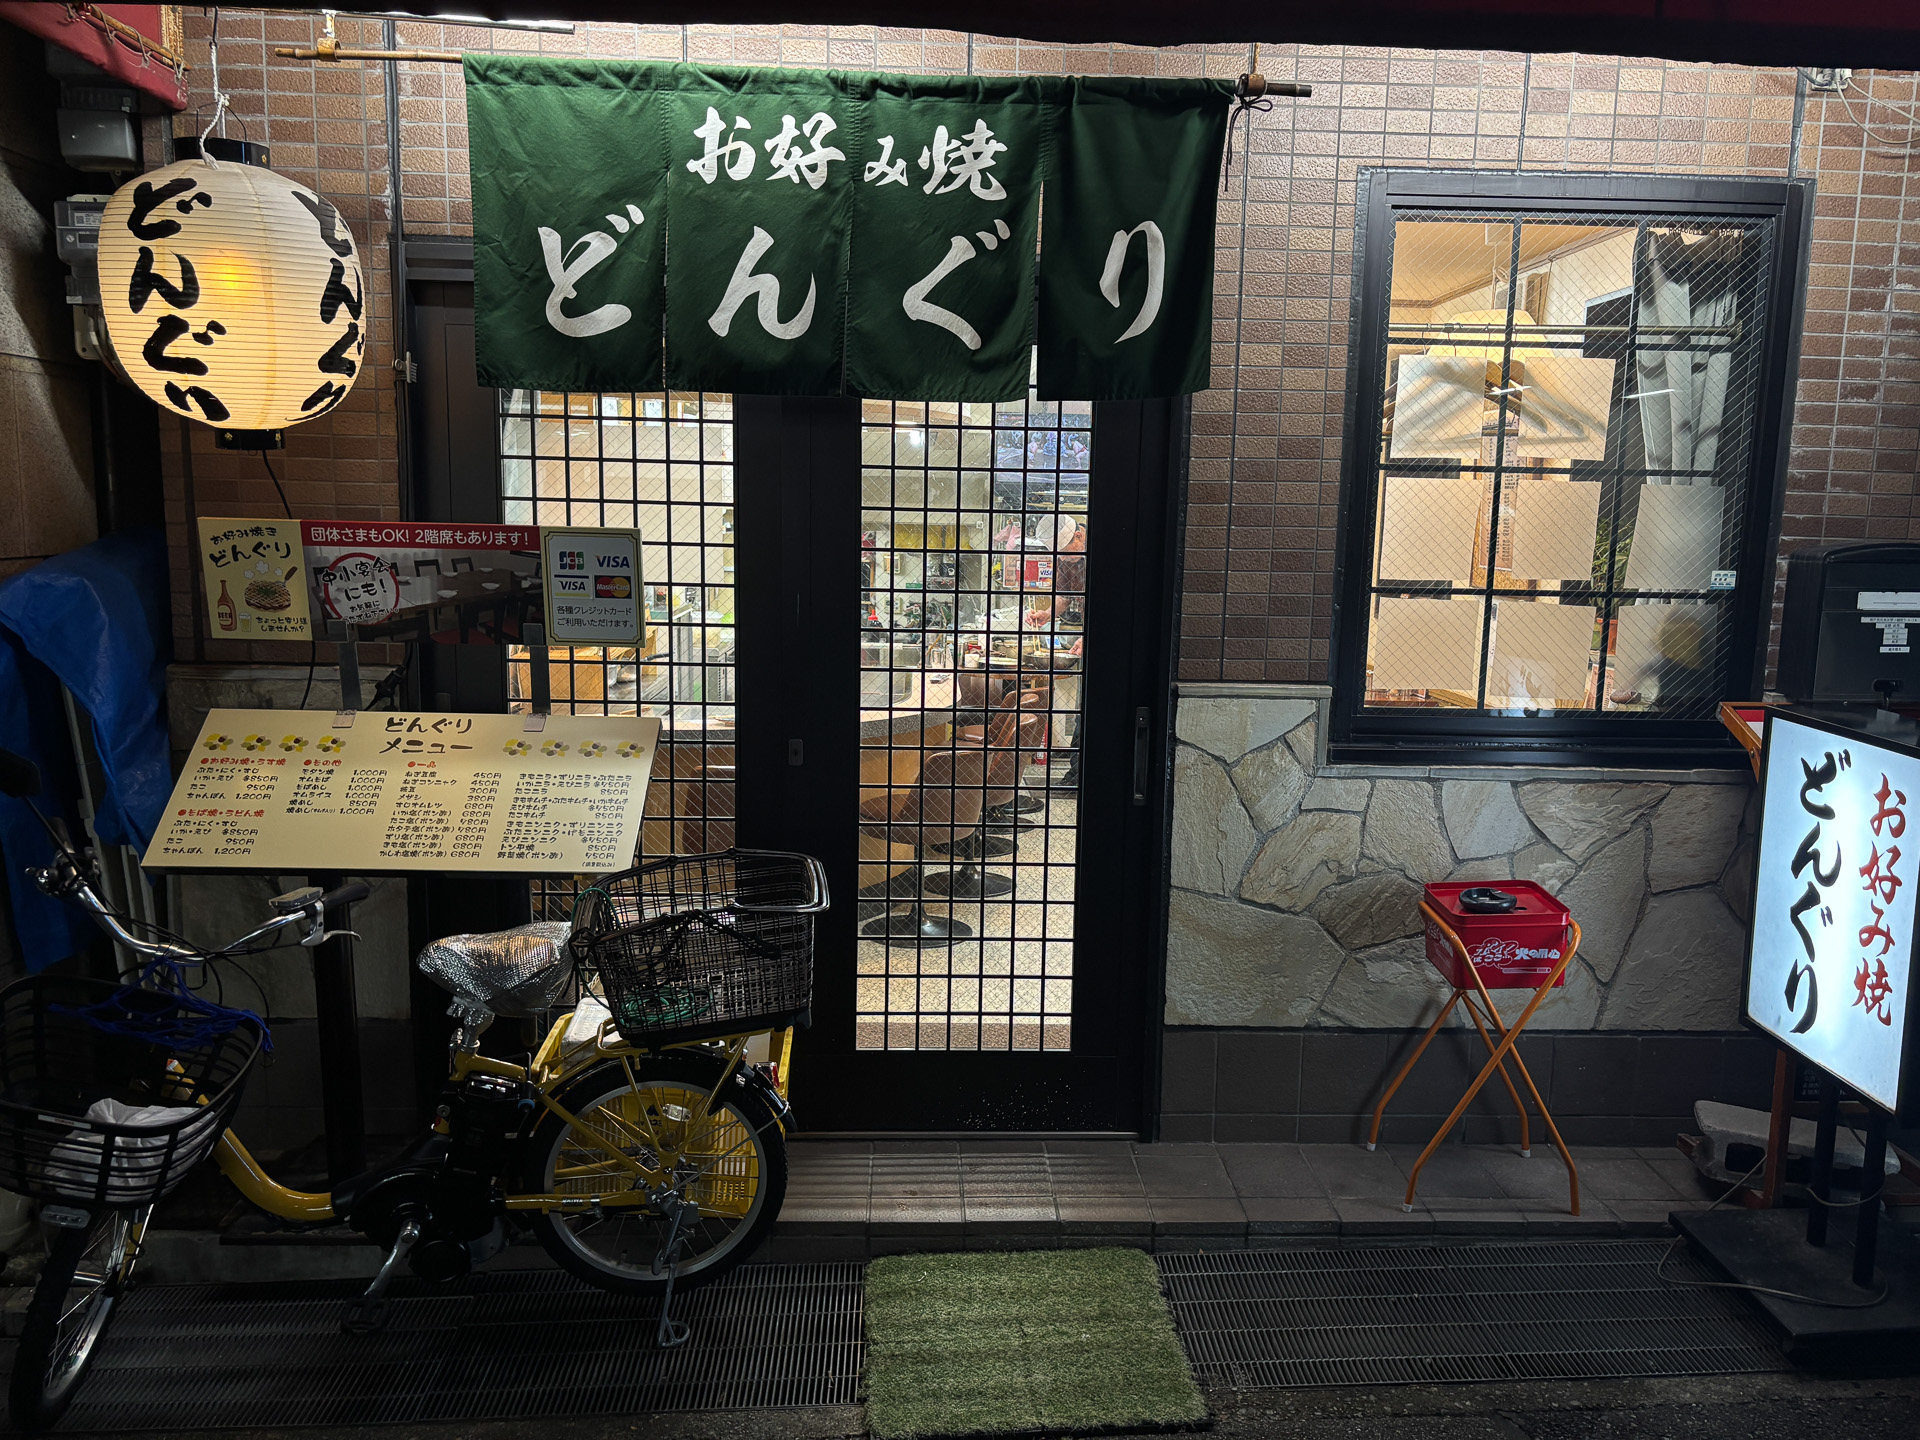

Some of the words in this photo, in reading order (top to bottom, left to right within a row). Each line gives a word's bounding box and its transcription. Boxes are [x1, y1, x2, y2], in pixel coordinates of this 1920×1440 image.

[686, 106, 1008, 200] お好み焼
[538, 203, 1166, 350] どんぐり
[127, 178, 230, 422] どんぐり
[210, 526, 278, 545] お好み焼き
[311, 526, 410, 543] 団体さまもOK!
[415, 529, 529, 546] 2階席もあります!
[209, 541, 291, 568] どんぐり
[595, 555, 630, 568] VISA
[322, 556, 391, 585] 中小宴会
[344, 578, 387, 601] にも!
[559, 581, 586, 590] VISA
[349, 601, 380, 612] お気軽に
[557, 606, 632, 615] 各種クレジットカード
[558, 618, 633, 628] ご利用いただけます。
[385, 717, 472, 734] どんぐり
[379, 737, 473, 754] メニュー
[1784, 749, 1851, 1034] どんぐり
[1851, 772, 1906, 1026] お好み焼
